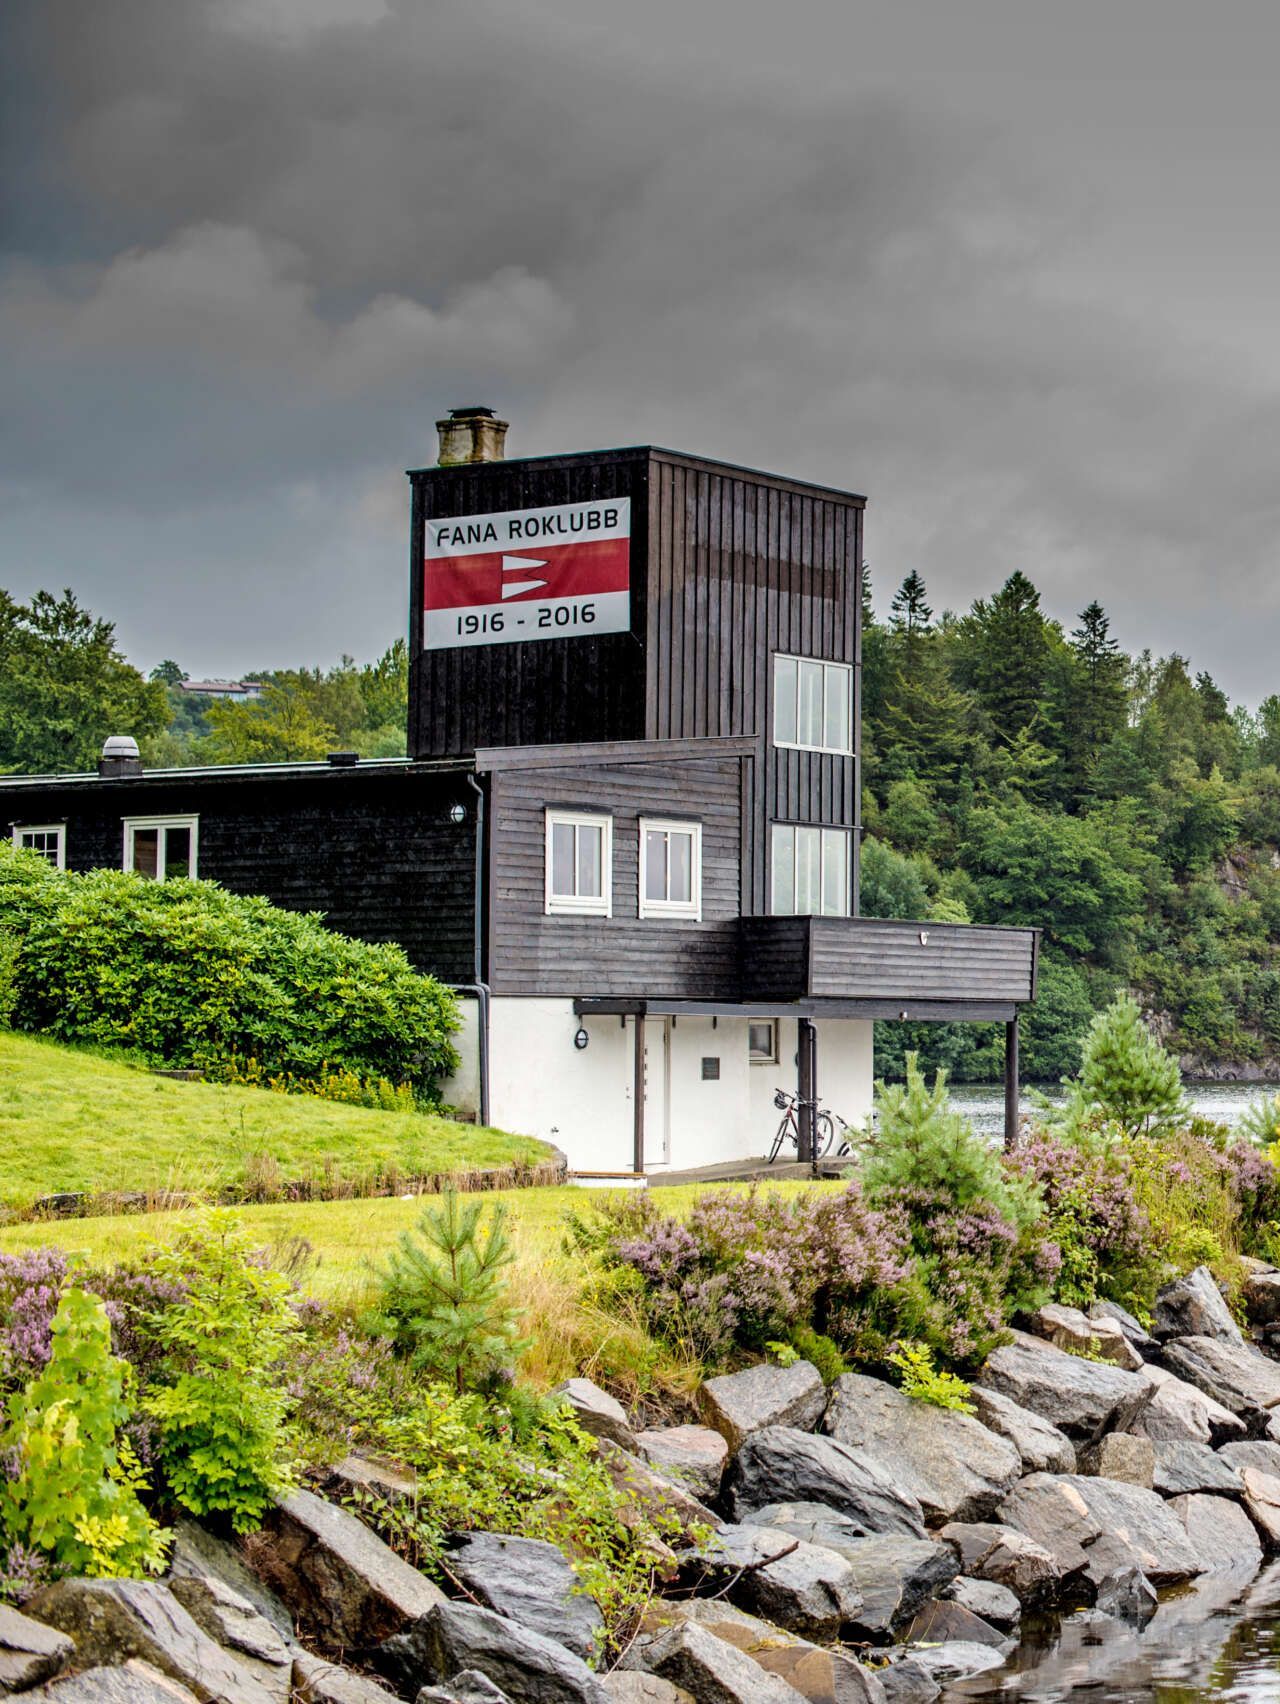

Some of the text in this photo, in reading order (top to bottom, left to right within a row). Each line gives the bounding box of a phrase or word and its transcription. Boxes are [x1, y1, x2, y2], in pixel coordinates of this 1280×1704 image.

[436, 508, 619, 547] FANA ROKLUBB
[457, 612, 505, 635] 1916
[538, 603, 596, 628] 2016
